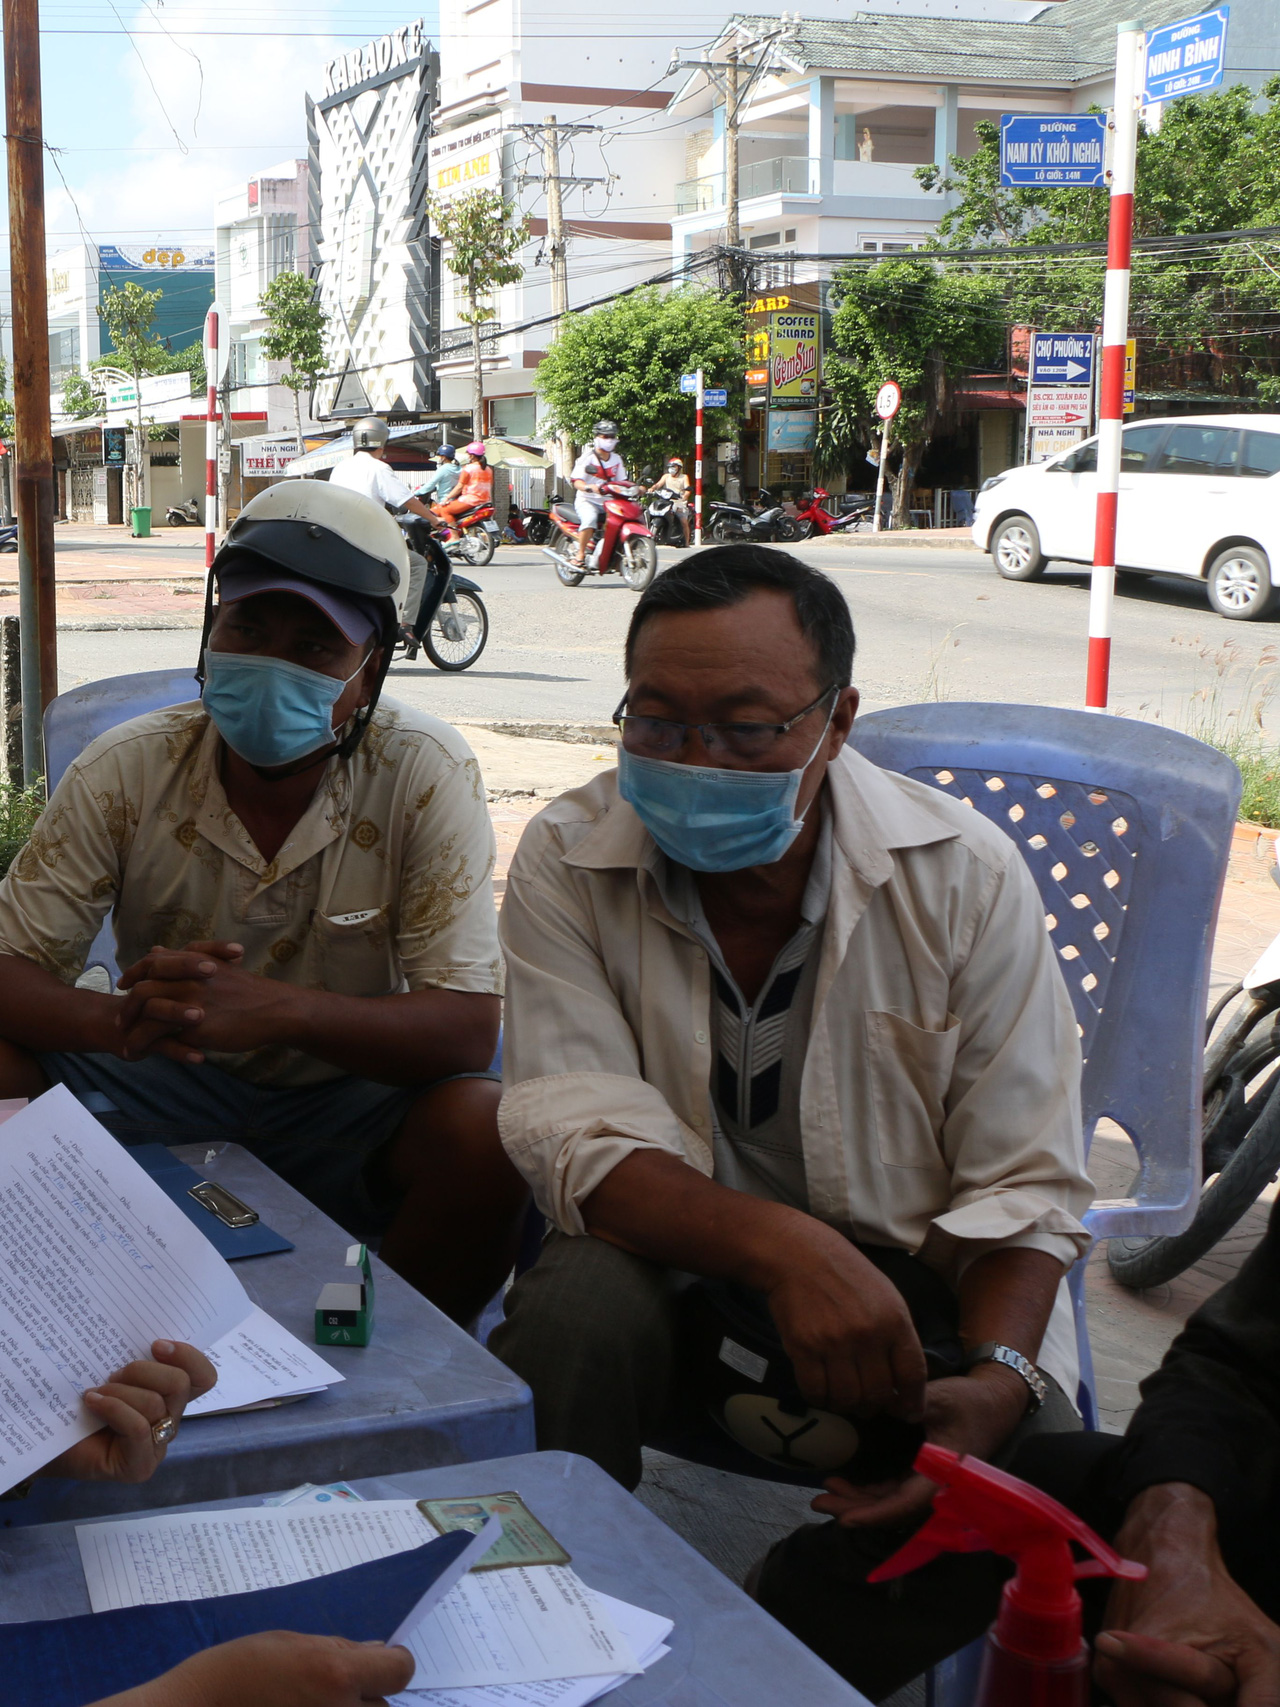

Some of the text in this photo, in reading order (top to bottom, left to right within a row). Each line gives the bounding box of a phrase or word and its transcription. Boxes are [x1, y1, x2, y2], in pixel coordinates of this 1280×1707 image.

[1171, 24, 1200, 42] ĐƯỜNG
[321, 18, 423, 99] KARAOKE
[1148, 36, 1219, 78] NINH BÌNH
[1165, 83, 1173, 94] LỘ
[1040, 122, 1076, 133] ĐƯỜNG
[1007, 135, 1101, 163] NAM KỲ KHỞI NGHĨA
[437, 153, 490, 189] KIM ANH
[1035, 170, 1080, 181] LỘ GIỚI: 14M
[777, 316, 815, 327] COFFEE
[1036, 336, 1090, 360] CHỢ PHƯỜNG 2
[1057, 428, 1075, 436] NGHỈ
